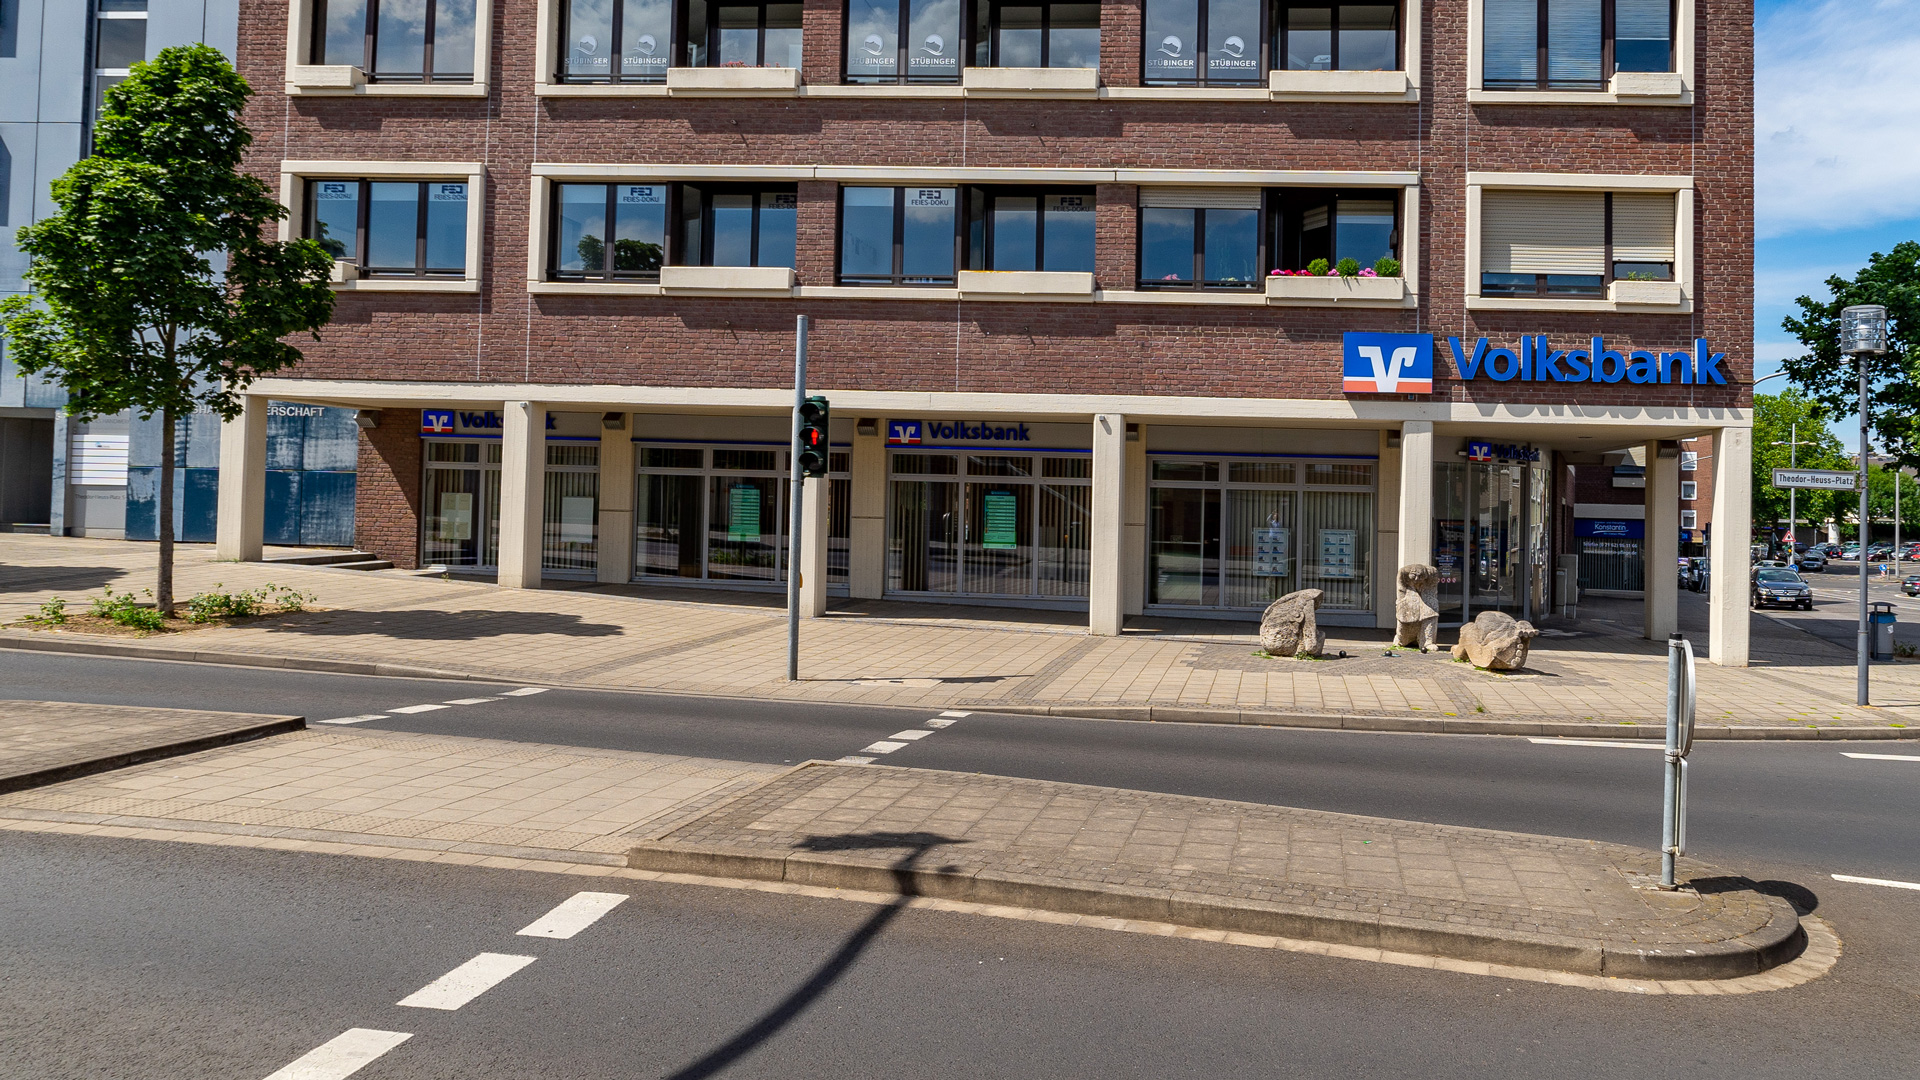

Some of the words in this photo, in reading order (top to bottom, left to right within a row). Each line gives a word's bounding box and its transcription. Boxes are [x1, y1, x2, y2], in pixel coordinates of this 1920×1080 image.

[564, 56, 608, 64] STÜBINGER
[623, 56, 667, 64] STÜBINGER
[910, 57, 956, 65] STÜBINGER
[1148, 58, 1195, 66] STÜBINGER
[1210, 59, 1257, 67] STÜBINGER
[1447, 334, 1728, 385] Volksbank
[267, 406, 325, 417] ERSCHAFT
[927, 421, 1030, 441] Volksbank
[1778, 473, 1854, 485] Theodor-Heuss-Platz
